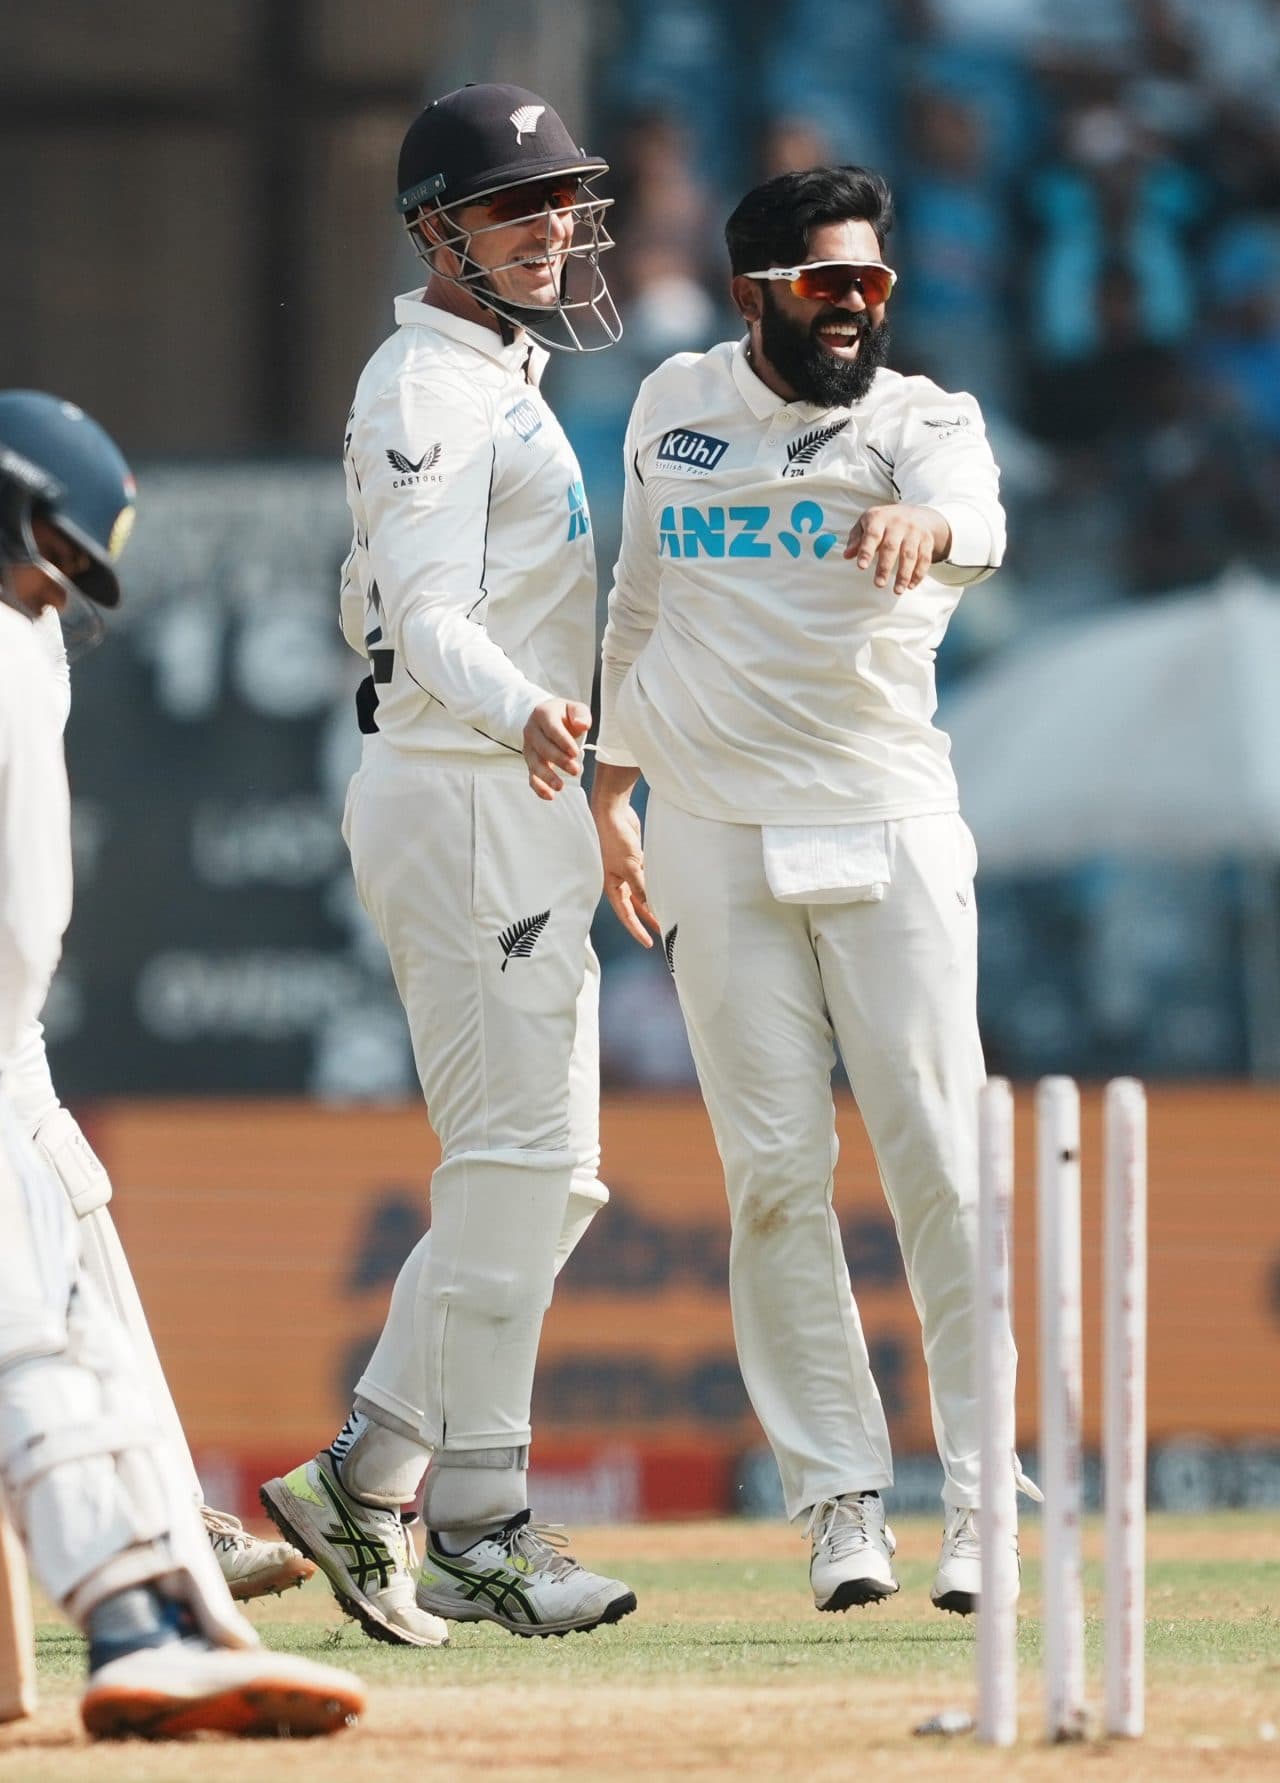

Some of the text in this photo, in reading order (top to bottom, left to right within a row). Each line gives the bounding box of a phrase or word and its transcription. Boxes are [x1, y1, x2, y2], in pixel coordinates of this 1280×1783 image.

[790, 468, 805, 478] 274
[392, 475, 443, 489] CASTORE
[658, 505, 772, 559] ANZ
